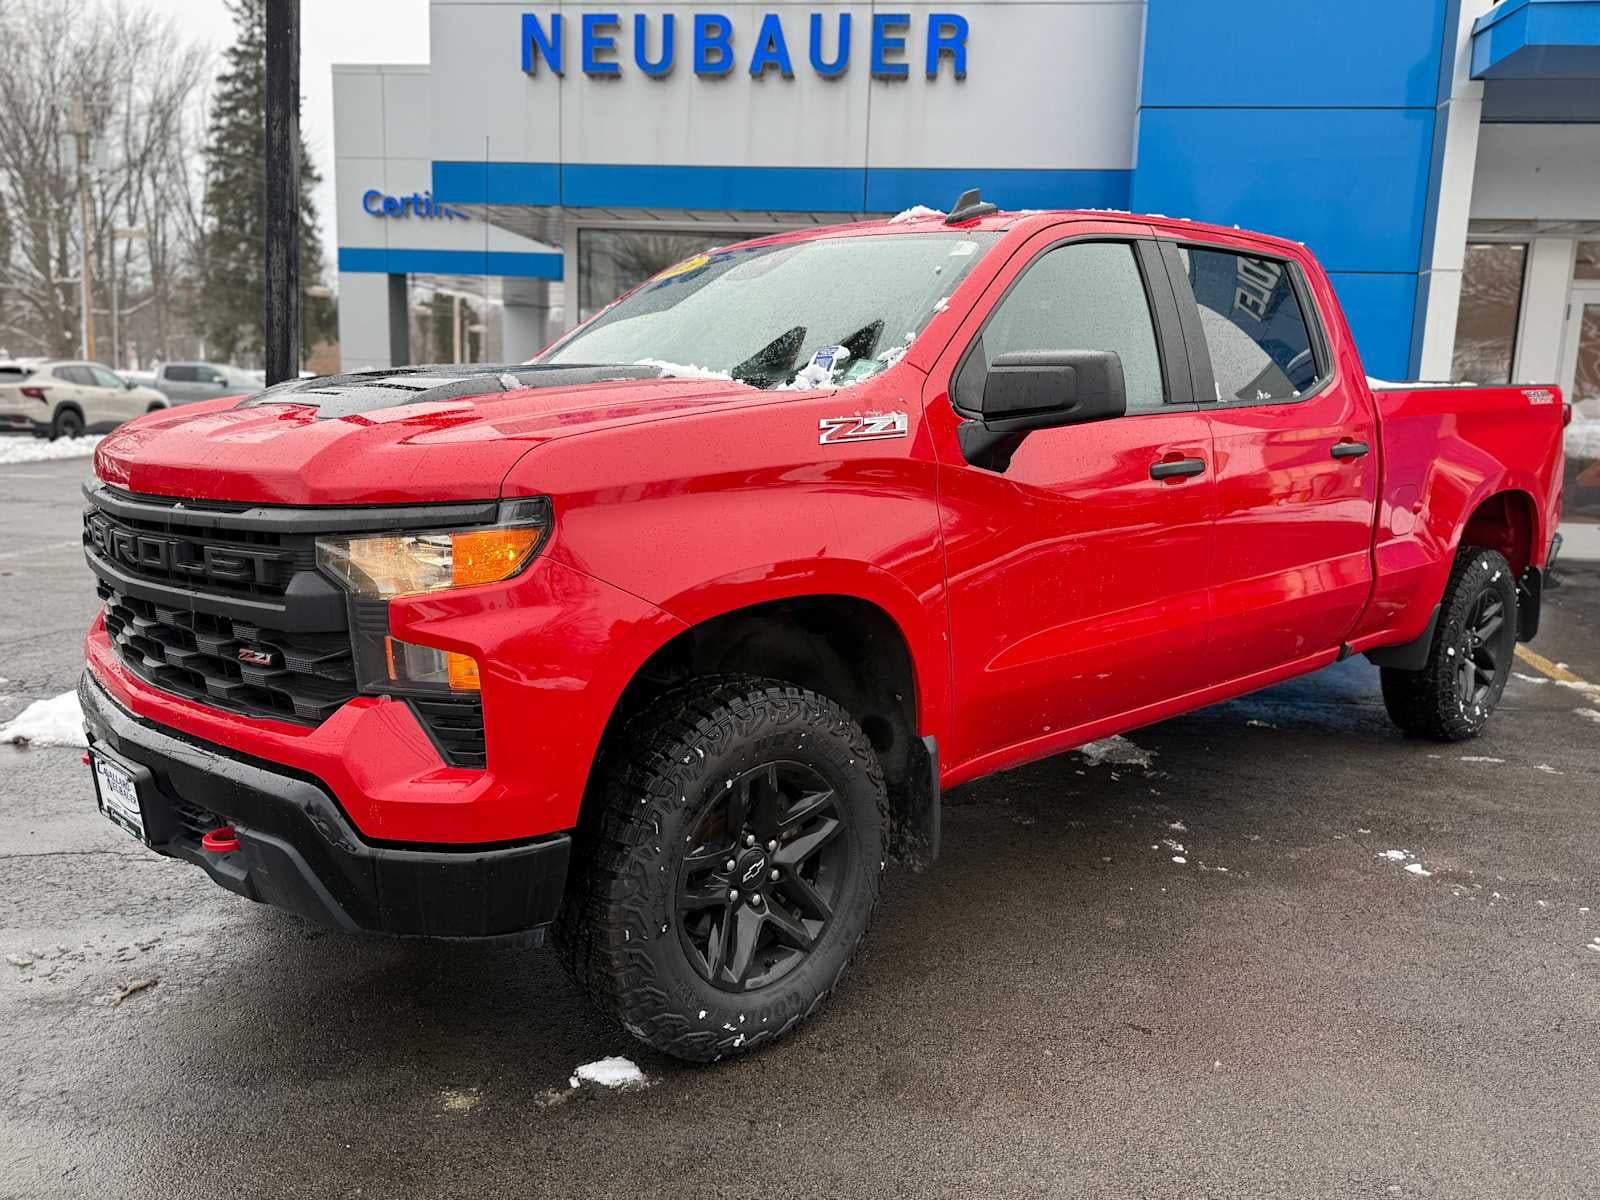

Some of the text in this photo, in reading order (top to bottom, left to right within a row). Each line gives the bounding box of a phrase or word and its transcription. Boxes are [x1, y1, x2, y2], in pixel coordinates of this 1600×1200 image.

[521, 13, 969, 79] NEUBAUER
[819, 412, 908, 445] Z71
[85, 513, 284, 581] EVROLET
